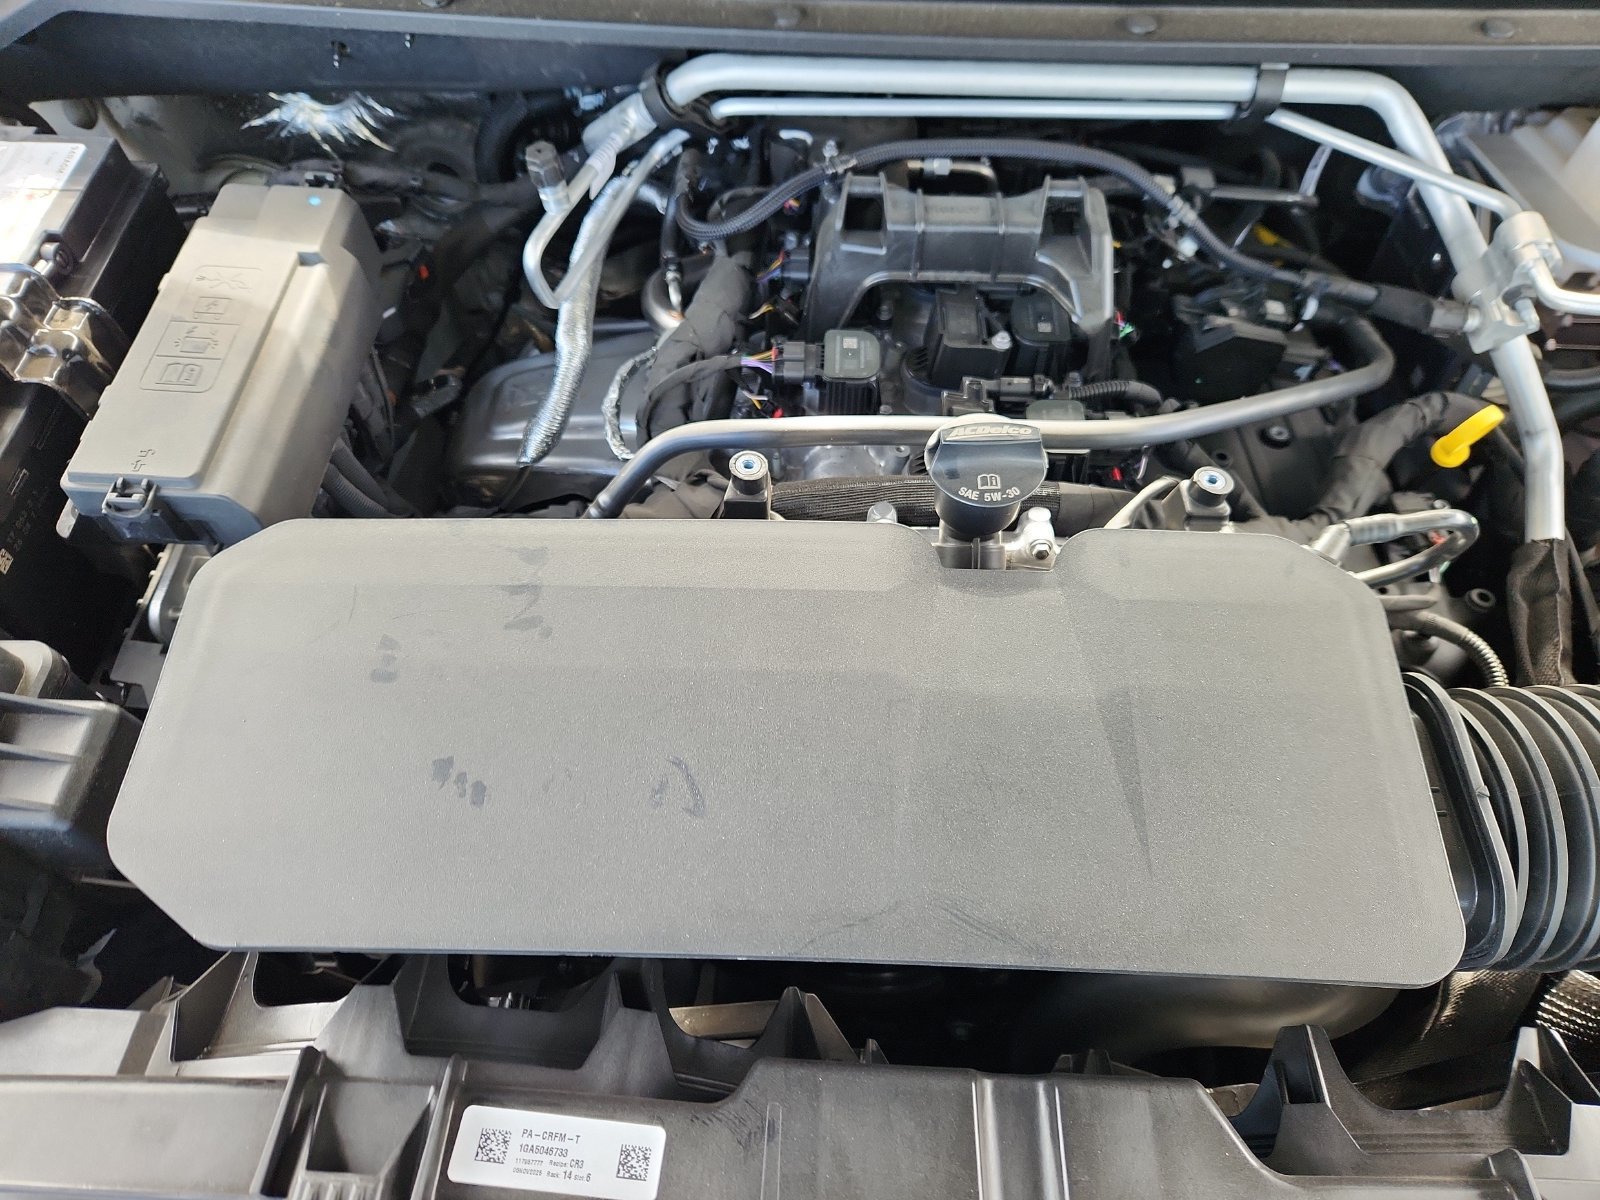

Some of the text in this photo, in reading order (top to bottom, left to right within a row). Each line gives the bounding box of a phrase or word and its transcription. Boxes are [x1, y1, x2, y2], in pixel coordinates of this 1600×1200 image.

[948, 425, 1033, 437] ACDelco
[958, 486, 1021, 502] SAE 5W-30
[519, 1142, 569, 1158] 1GA5046733
[569, 1158, 585, 1169] CR3
[563, 1170, 573, 1180] 14
[586, 1173, 592, 1182] 6
